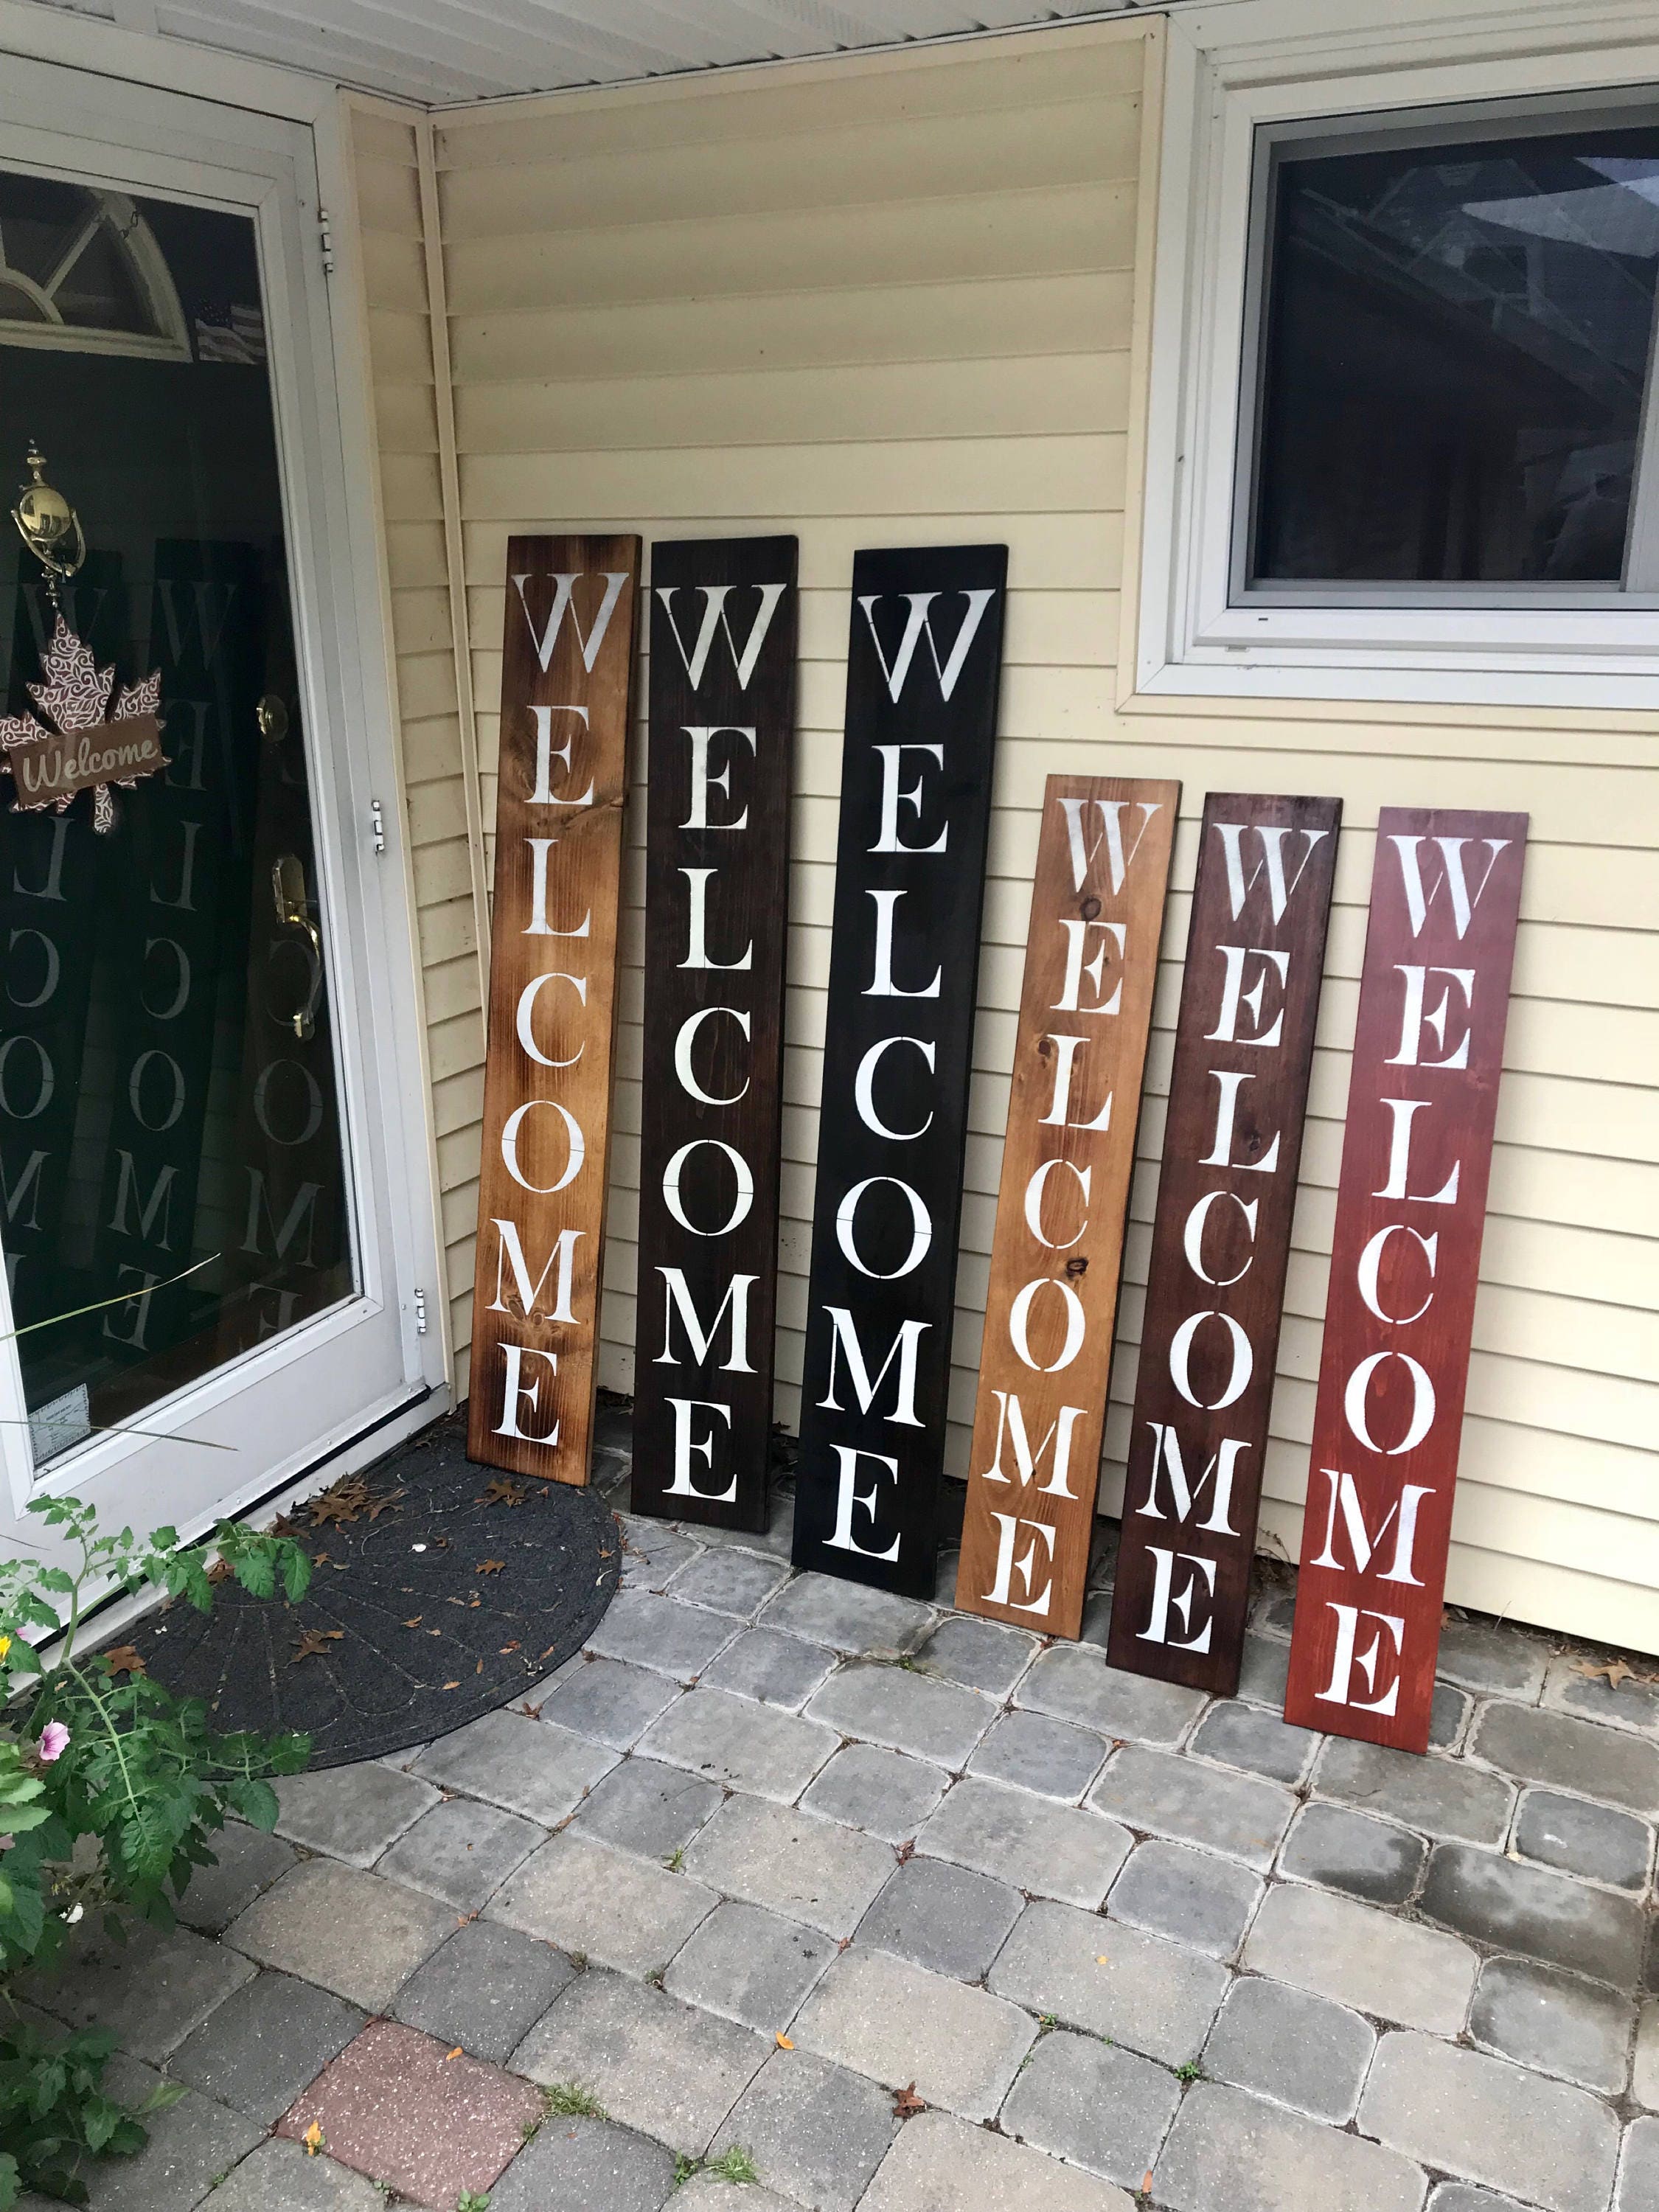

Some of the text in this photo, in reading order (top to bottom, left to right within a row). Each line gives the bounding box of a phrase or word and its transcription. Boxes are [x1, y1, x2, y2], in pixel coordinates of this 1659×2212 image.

[23, 737, 158, 792] Welcome
[484, 572, 630, 1447] WELCOME
[653, 583, 787, 1503] WELCOME
[815, 588, 996, 1563] WELCOME
[981, 797, 1164, 1616] WELCOME
[1135, 822, 1329, 1655] WELCOME
[1310, 834, 1513, 1717] WELCOME
